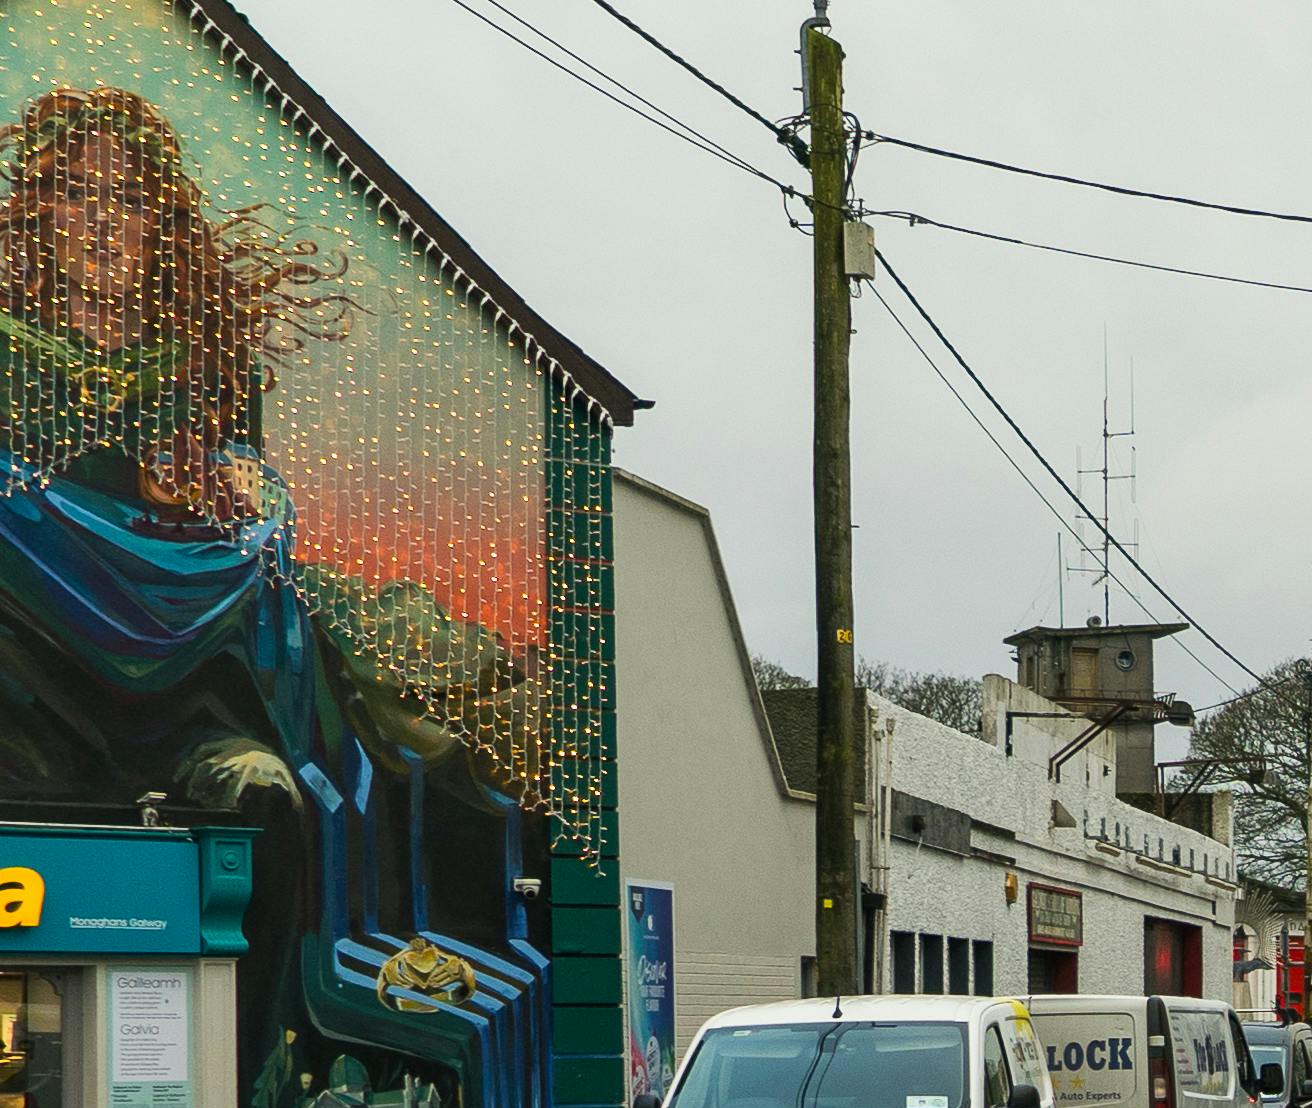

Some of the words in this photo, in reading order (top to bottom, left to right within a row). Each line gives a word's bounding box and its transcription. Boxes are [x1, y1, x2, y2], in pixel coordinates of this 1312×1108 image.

[70, 916, 128, 930] Monaghans
[129, 917, 168, 931] Galway
[1046, 1037, 1133, 1072] LOCK
[1060, 1092, 1085, 1101] Auto
[1086, 1090, 1122, 1101] Experts
